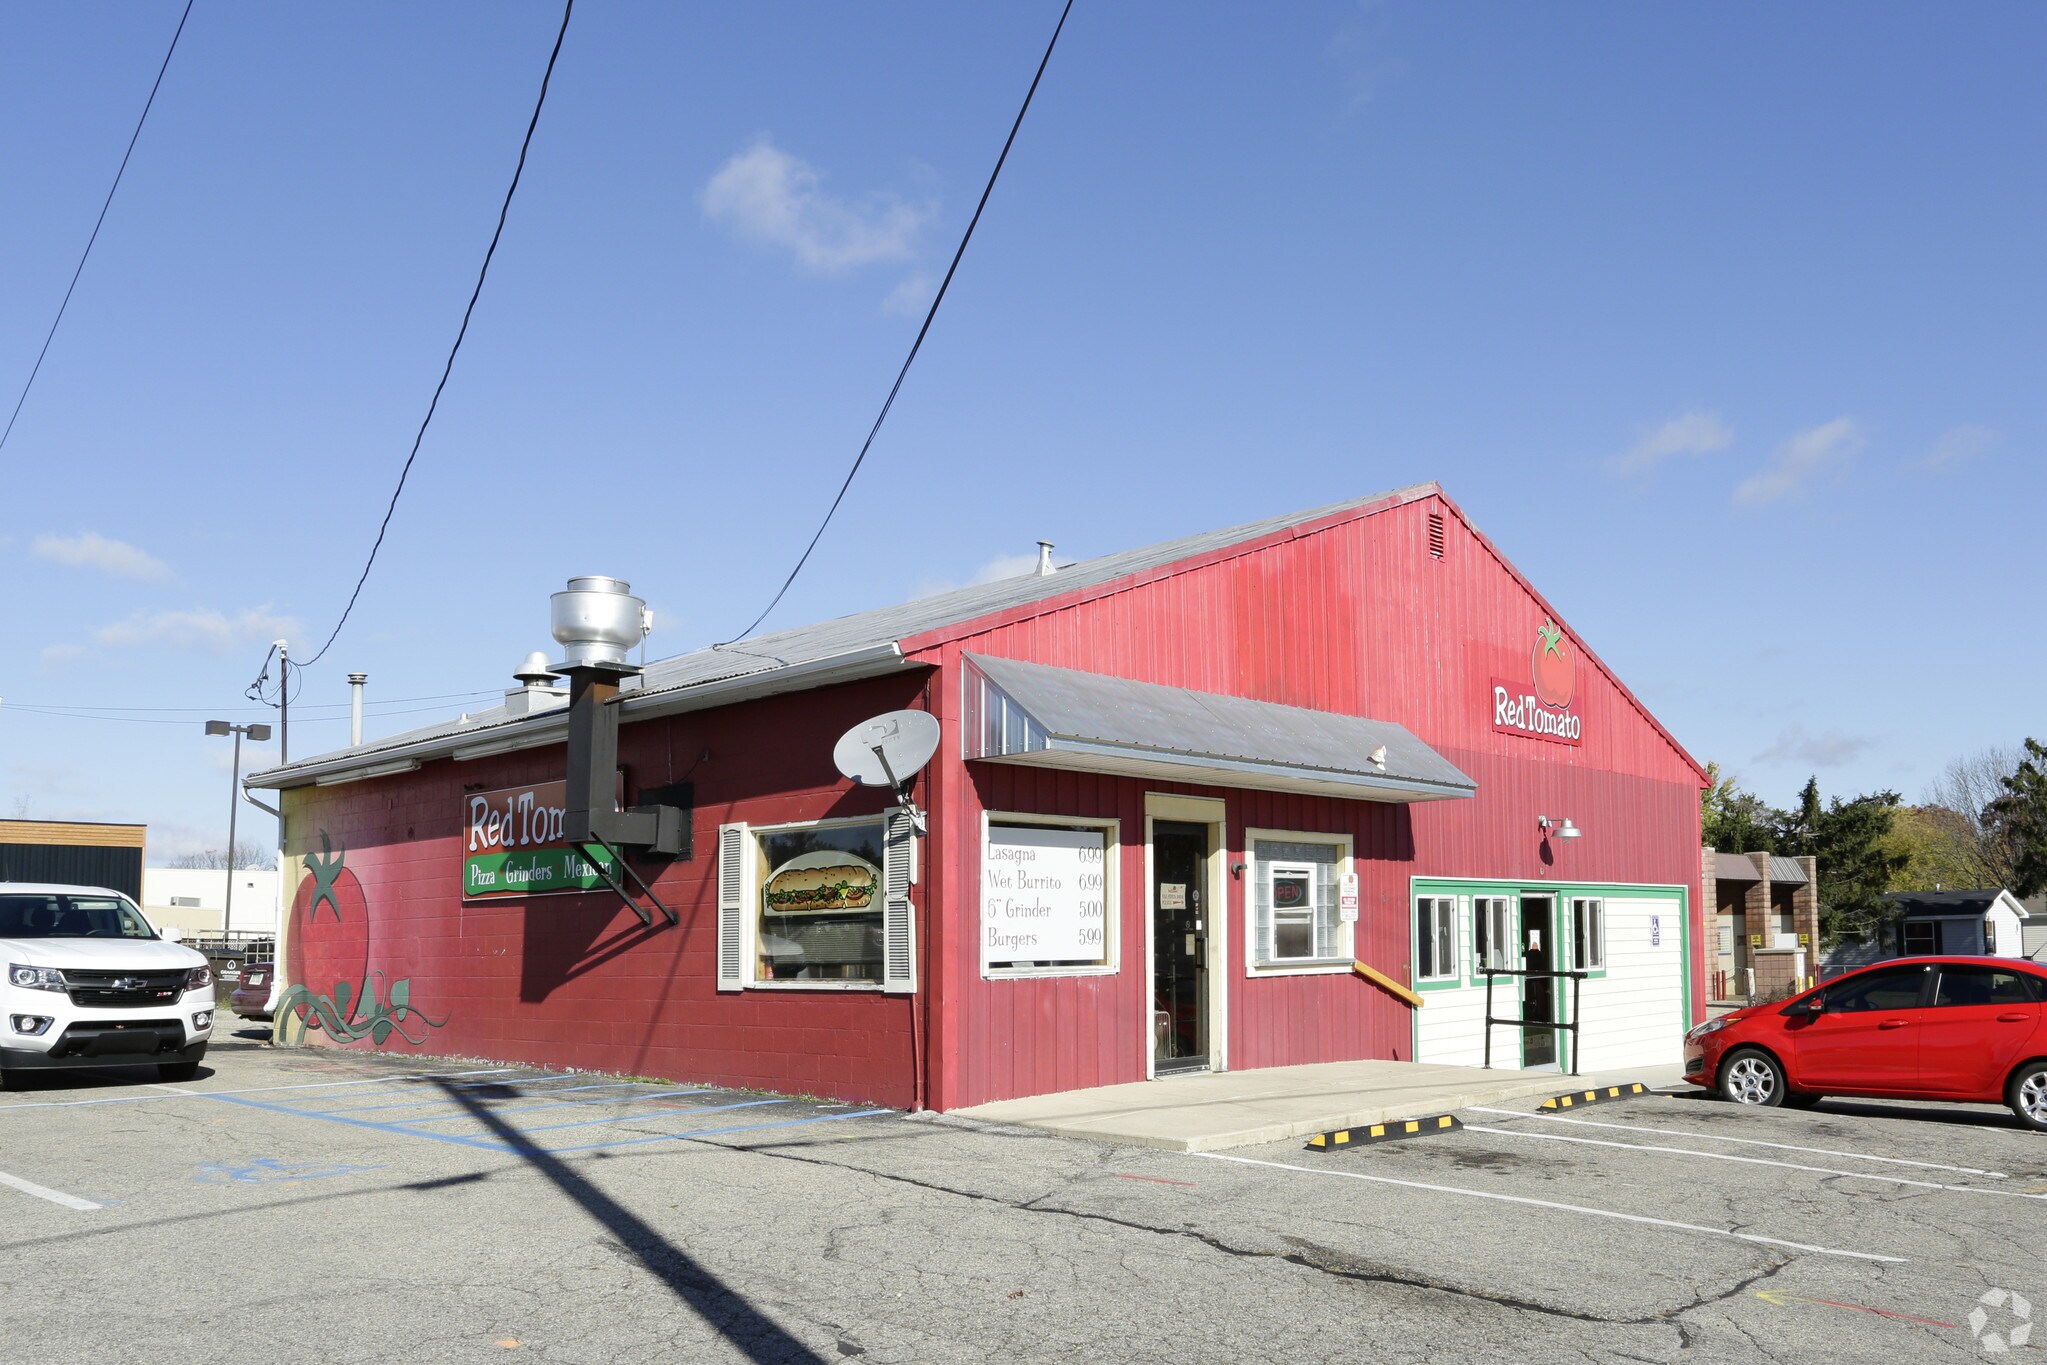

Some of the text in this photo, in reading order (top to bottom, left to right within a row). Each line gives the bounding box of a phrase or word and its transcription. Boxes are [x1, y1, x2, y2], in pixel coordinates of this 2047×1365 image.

[987, 840, 1036, 866] Lasagna
[470, 864, 496, 886] Pizza
[505, 856, 552, 884] Grinders
[988, 869, 1013, 889] Wet
[1017, 869, 1062, 890] Burrito
[1274, 885, 1299, 899] PEN
[1005, 896, 1052, 919] Grinder
[988, 926, 1038, 952] Burgers
